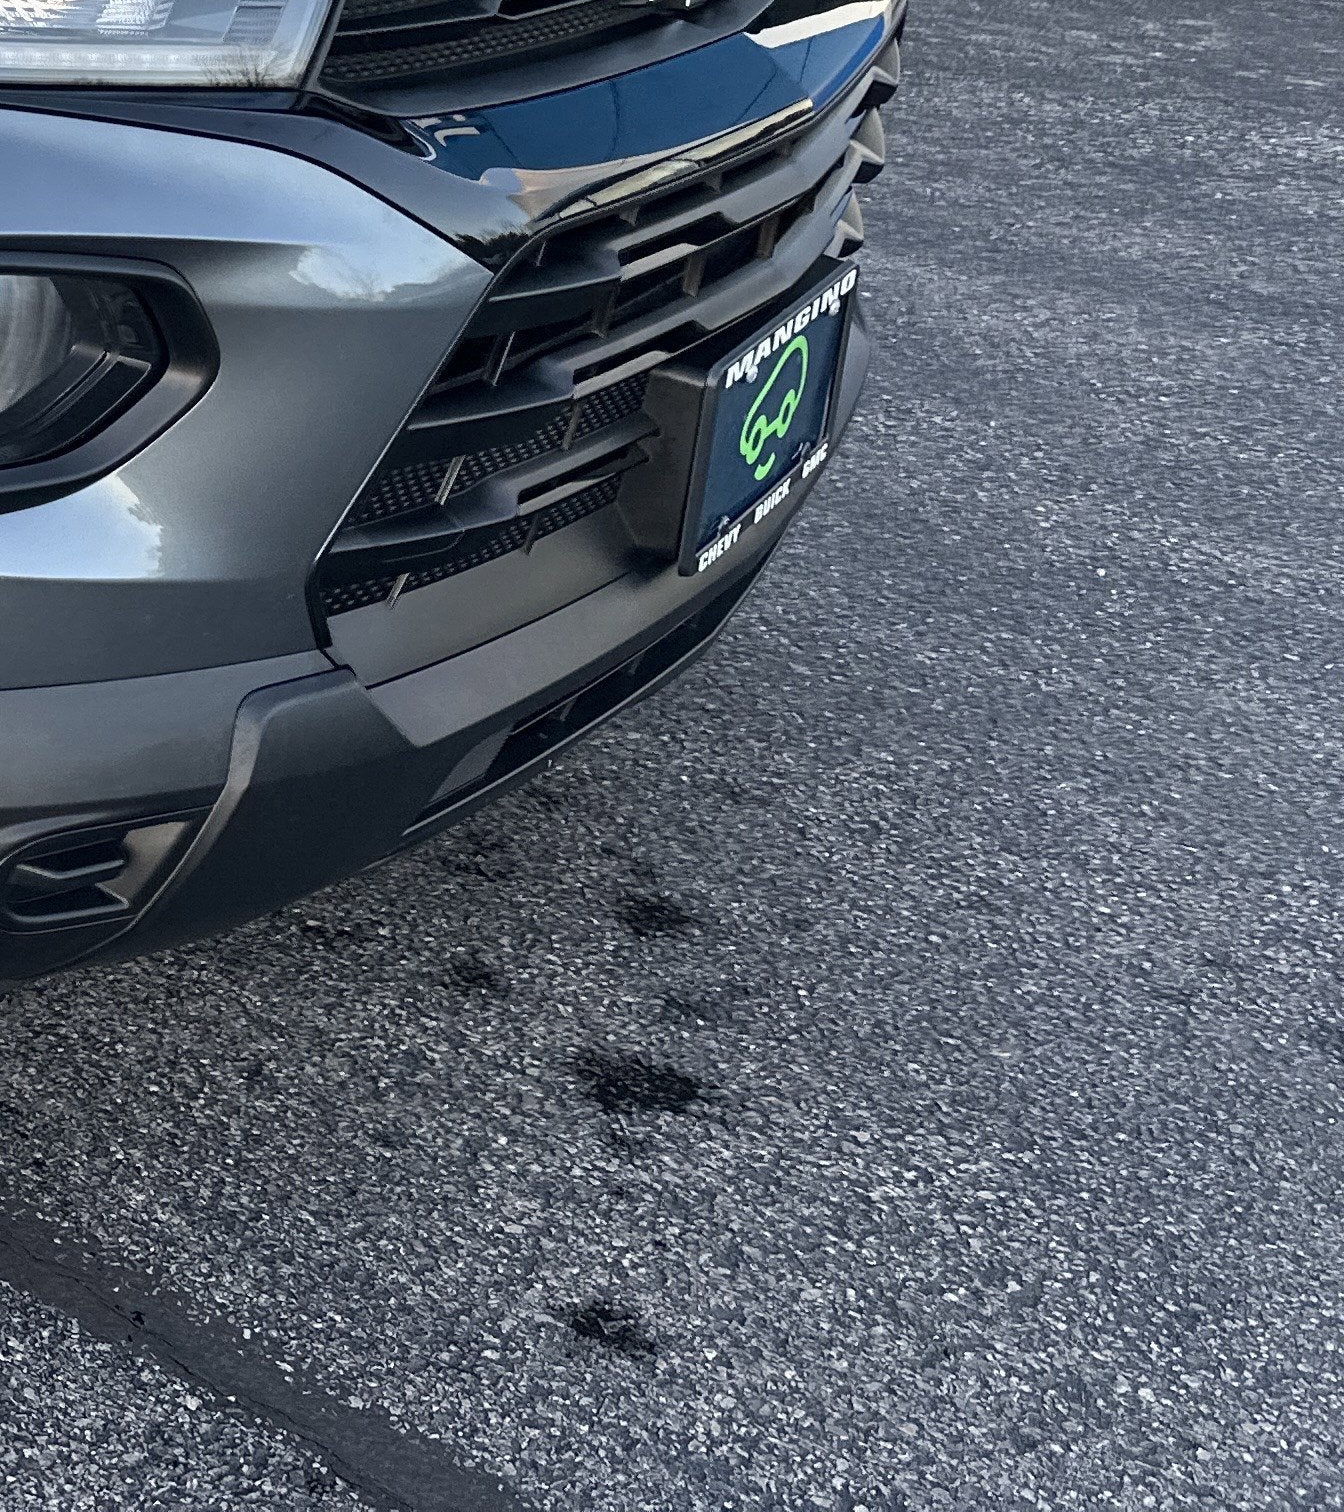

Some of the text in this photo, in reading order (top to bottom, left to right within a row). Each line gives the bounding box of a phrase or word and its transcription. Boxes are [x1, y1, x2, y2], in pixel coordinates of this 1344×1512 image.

[725, 269, 857, 388] MANGINO
[698, 523, 741, 572] CHEVY
[753, 477, 791, 524] BUICK
